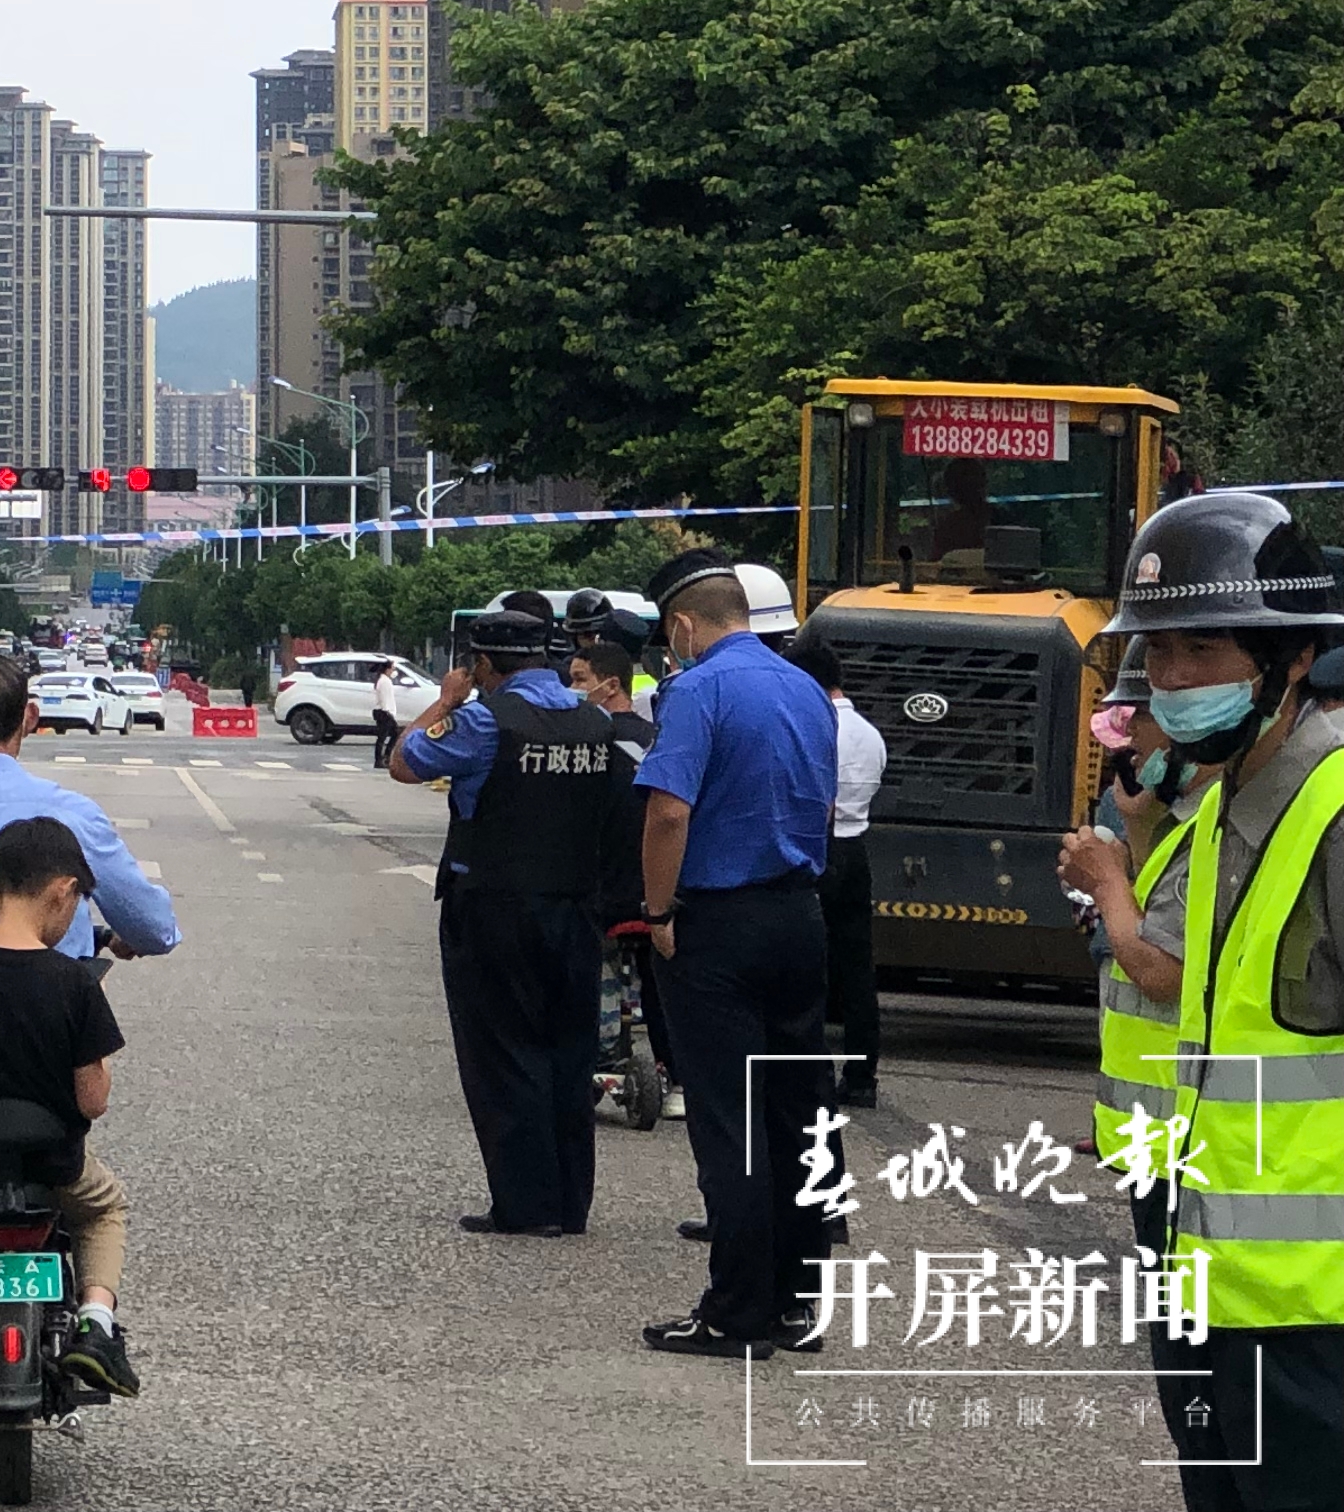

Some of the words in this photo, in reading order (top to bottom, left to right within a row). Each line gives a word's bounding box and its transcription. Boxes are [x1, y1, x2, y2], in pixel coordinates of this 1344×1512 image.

[912, 424, 1050, 457] 13888284339
[519, 743, 611, 775] 行政执法
